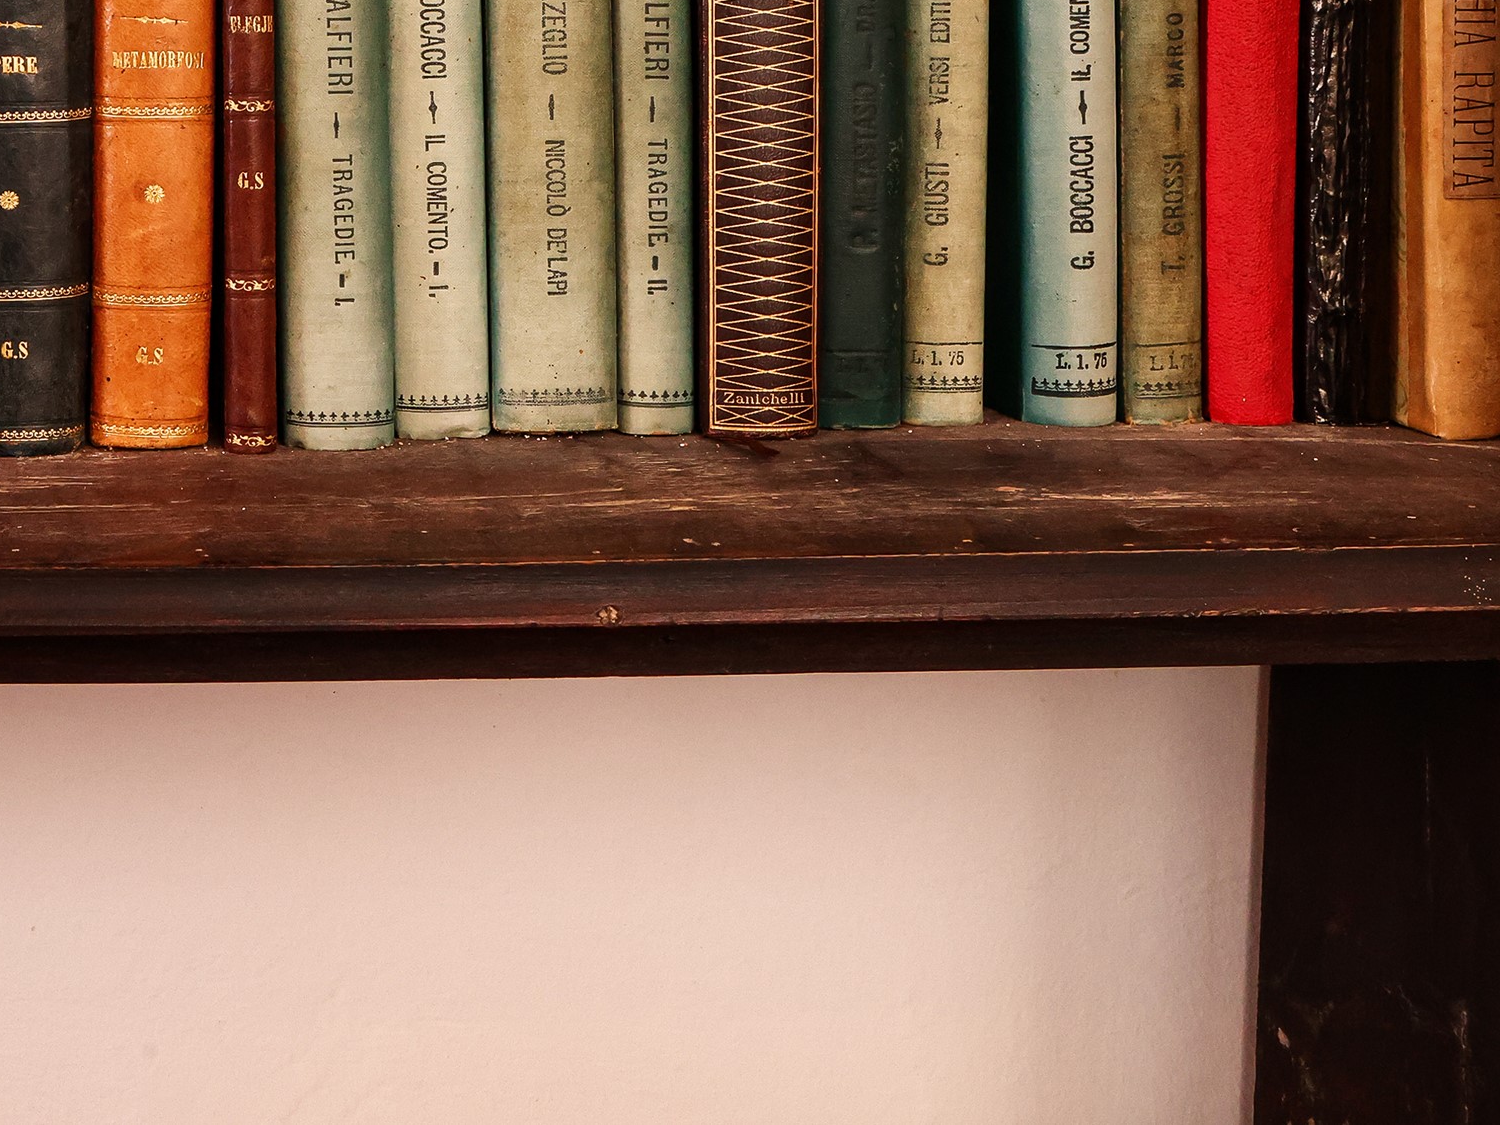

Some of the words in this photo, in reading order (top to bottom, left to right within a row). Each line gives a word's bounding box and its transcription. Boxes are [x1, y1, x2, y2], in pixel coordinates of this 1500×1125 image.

[326, 0, 354, 95] ALFIERI
[930, 2, 951, 44] EDITI
[112, 50, 204, 70] METAMORFOSI
[1165, 12, 1185, 88] MARCO
[929, 57, 950, 106] VERSI
[425, 134, 446, 151] IL
[1452, 70, 1496, 190] RAPITA
[545, 140, 572, 217] NICCOLÒ
[923, 162, 949, 226] GIUSTI
[1069, 135, 1094, 234] BOCCACCI
[1161, 153, 1185, 236] GROSSI
[426, 161, 449, 254] COMENTO.
[923, 246, 949, 266] G.
[1070, 250, 1095, 270] G.
[911, 349, 924, 365] L.
[948, 350, 964, 366] 75
[1055, 352, 1071, 369] L.
[1076, 353, 1089, 369] 1.
[723, 391, 805, 405] Zanichelli
